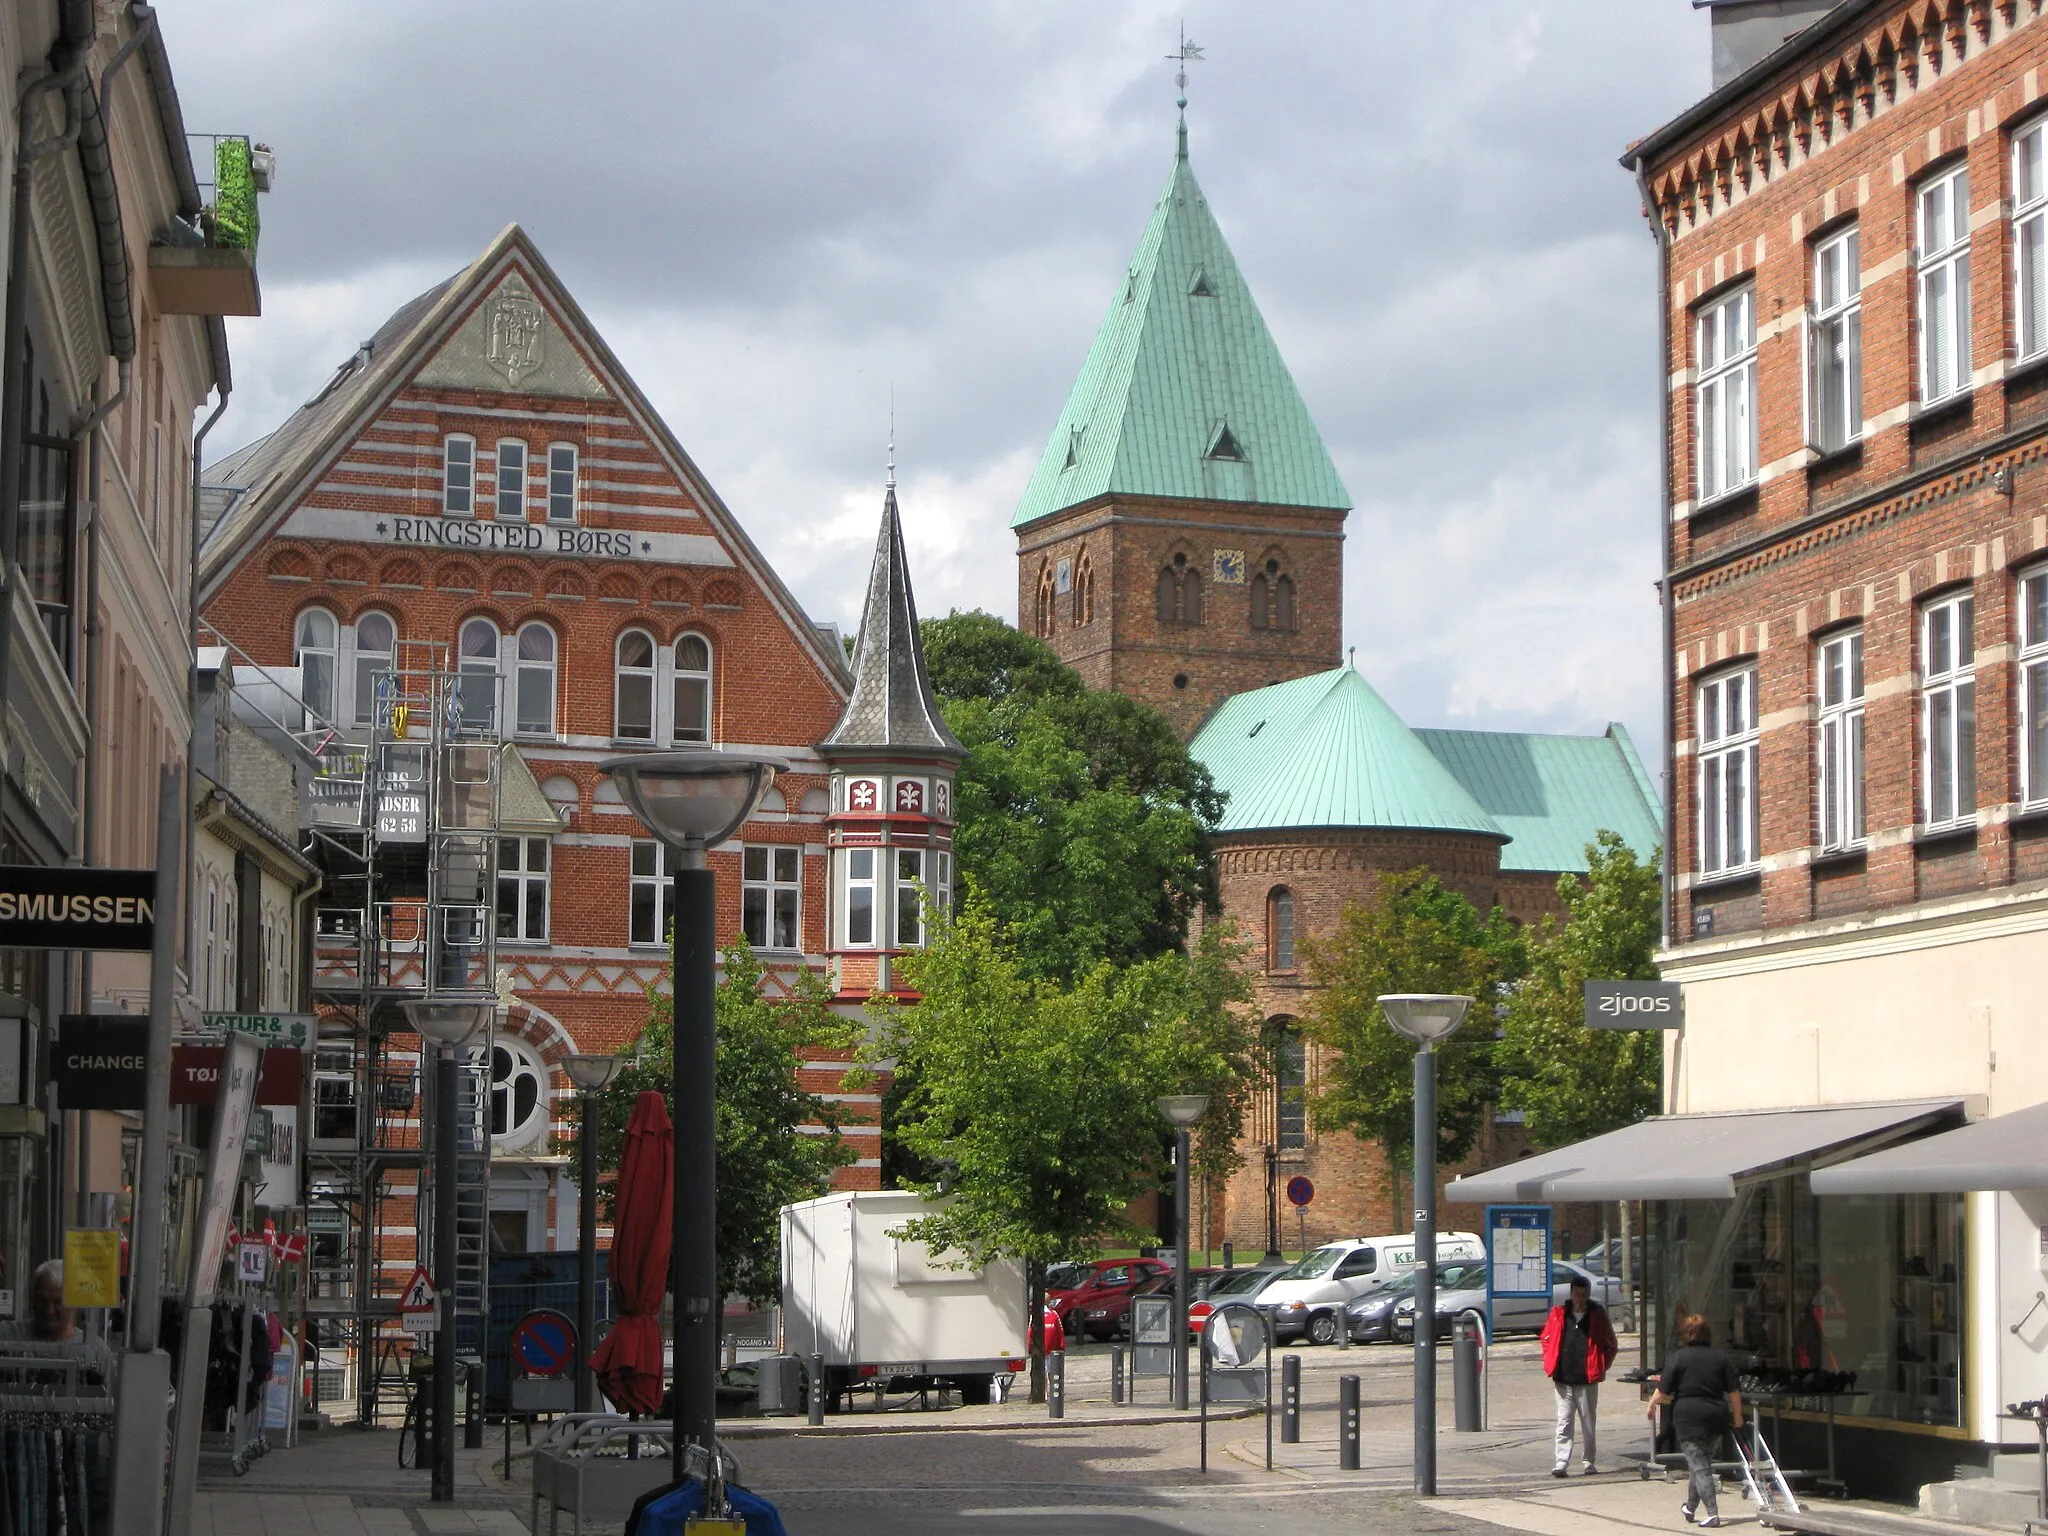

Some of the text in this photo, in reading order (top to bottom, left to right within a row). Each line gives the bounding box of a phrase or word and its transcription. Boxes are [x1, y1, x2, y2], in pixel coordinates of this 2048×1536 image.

[393, 518, 632, 556] RINGSTED BØRS
[380, 817, 417, 833] 62 58
[1599, 992, 1671, 1016] zjoos
[269, 1016, 282, 1032] &
[67, 1055, 145, 1070] CHANGE
[735, 1338, 762, 1347] NDGANG
